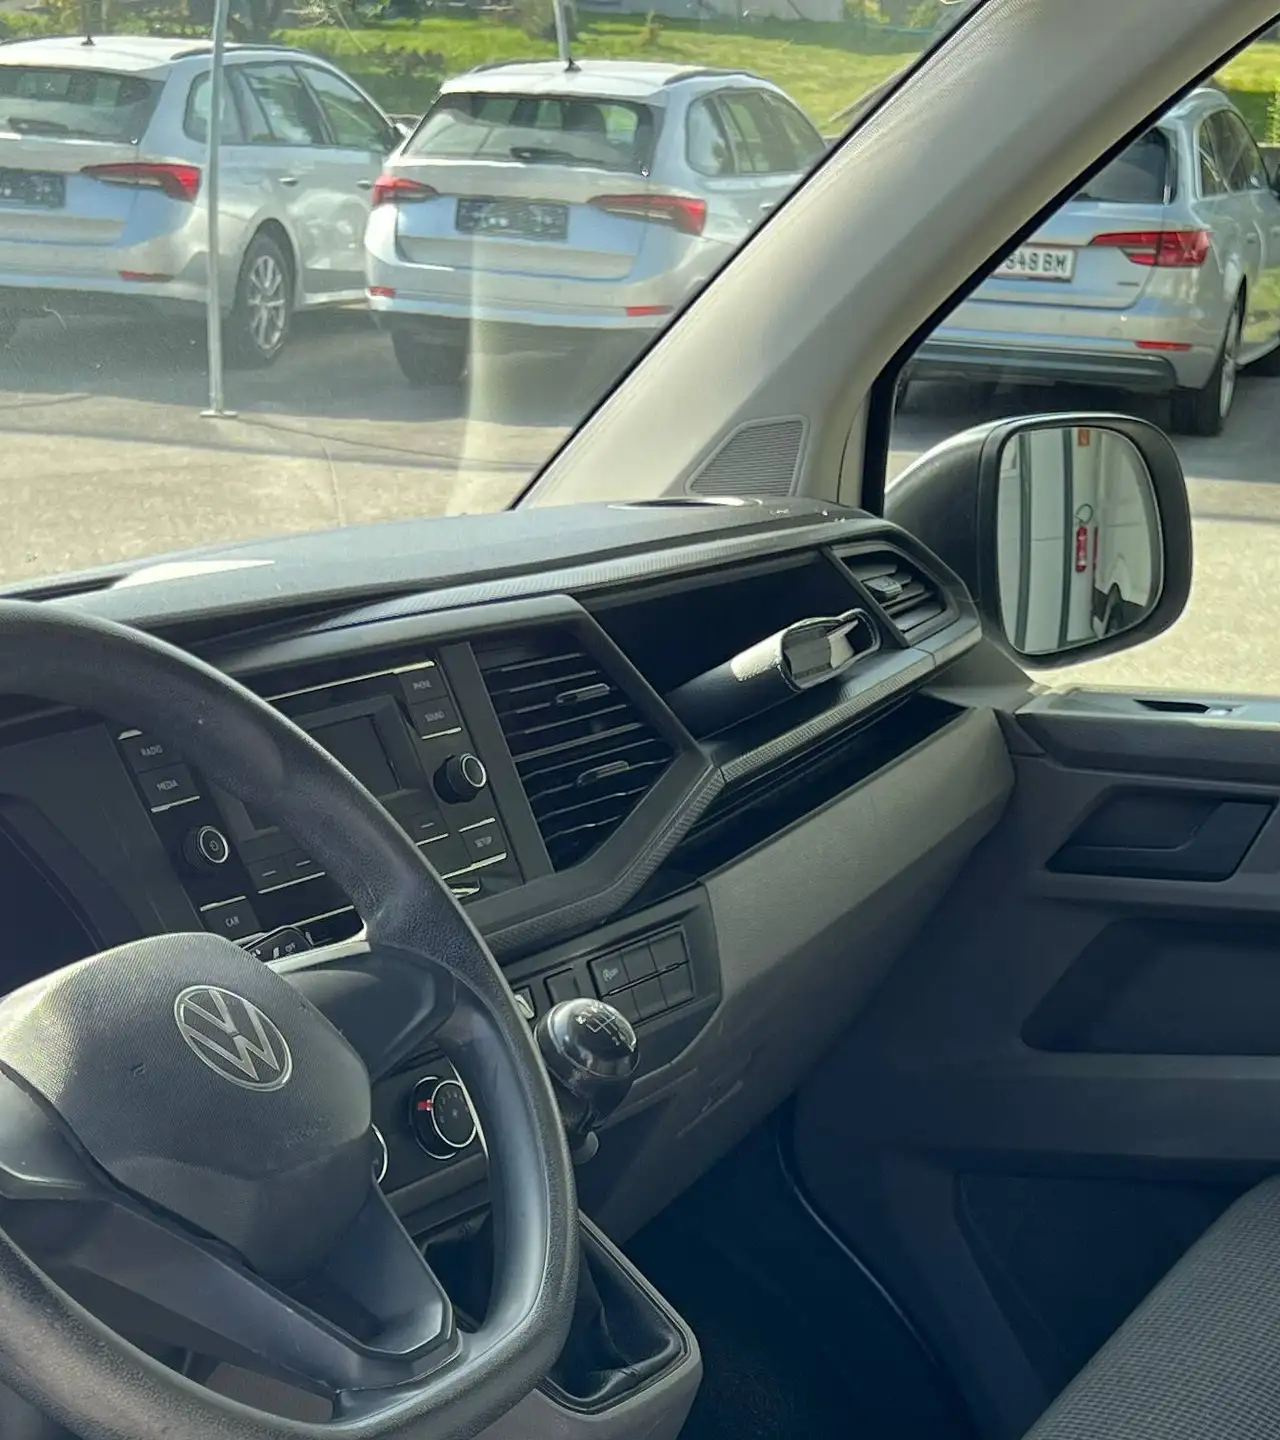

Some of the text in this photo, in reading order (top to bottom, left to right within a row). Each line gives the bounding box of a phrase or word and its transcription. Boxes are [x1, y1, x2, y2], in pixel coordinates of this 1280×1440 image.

[424, 710, 445, 722] SOUND
[140, 744, 164, 758] RADIO
[156, 779, 179, 792] MEDIA
[474, 836, 493, 849] SETUP
[224, 915, 241, 928] CAR
